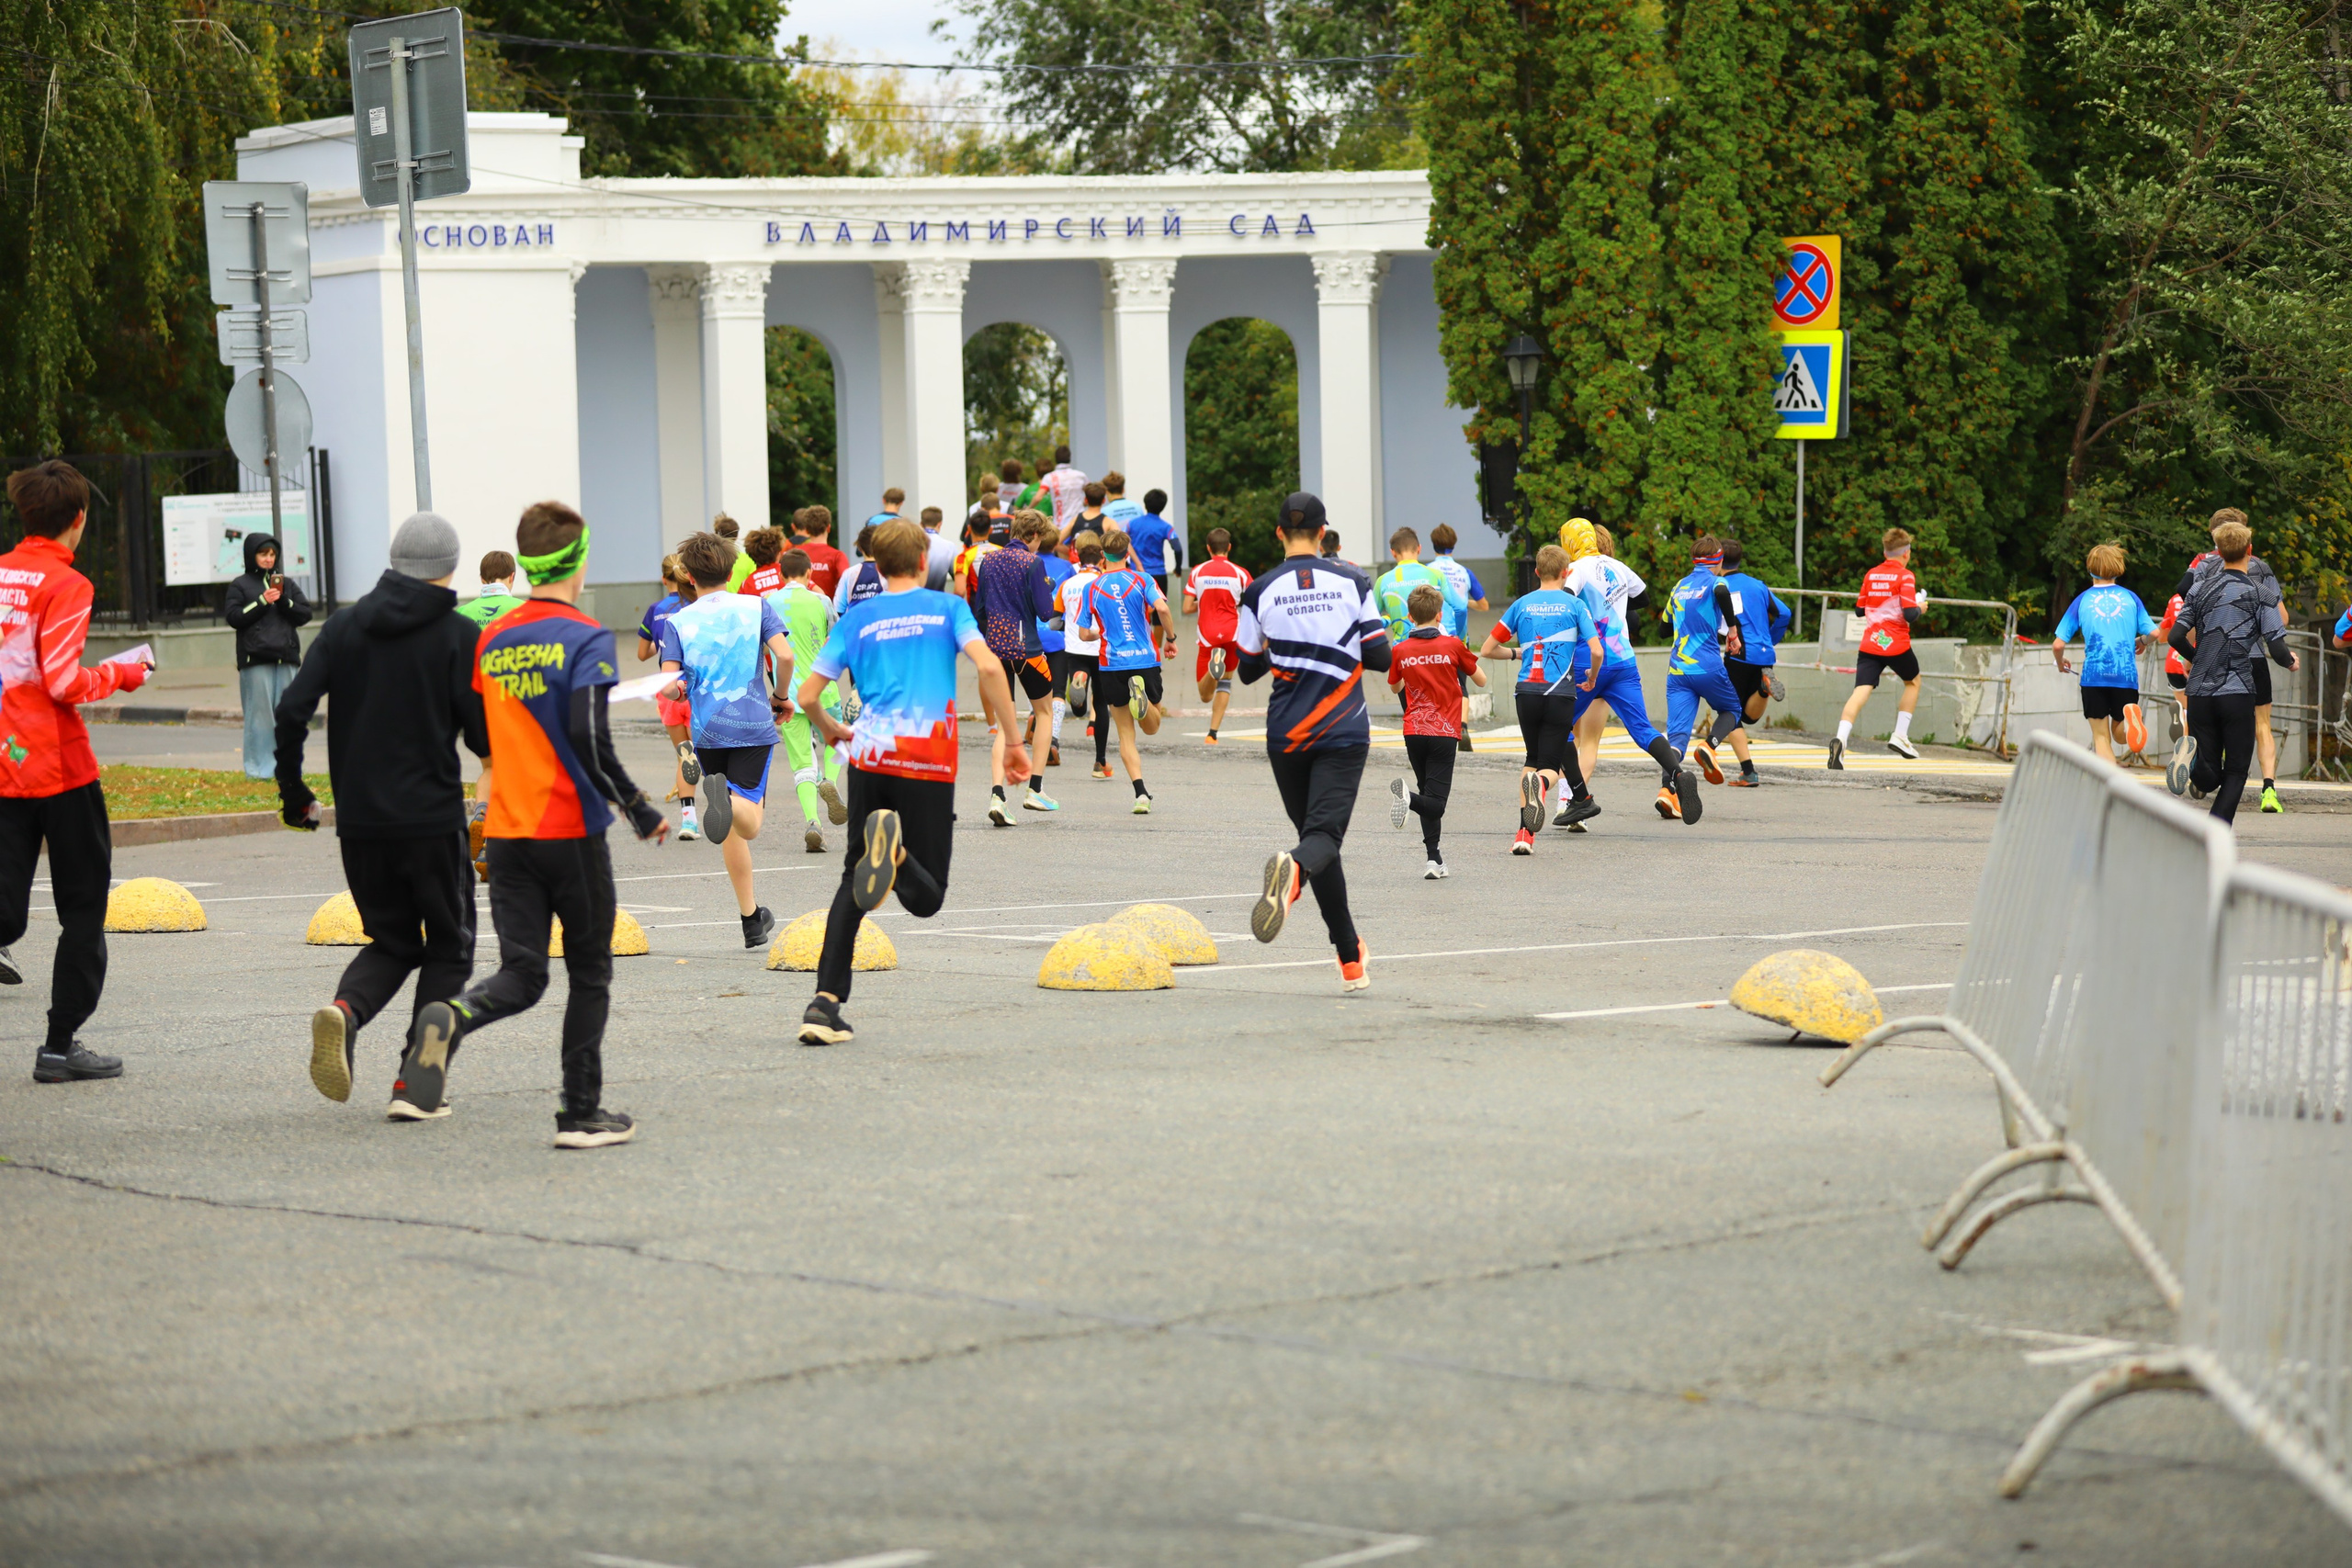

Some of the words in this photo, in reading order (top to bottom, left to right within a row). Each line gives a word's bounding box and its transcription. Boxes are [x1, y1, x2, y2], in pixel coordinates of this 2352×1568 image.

[766, 209, 1182, 243] ВЛАДИМИРСКИЙ
[1228, 213, 1316, 236] САД
[754, 575, 780, 591] STAR
[1204, 579, 1230, 587] RUSSIA
[1386, 578, 1430, 590] УЛЬЯНОВСК
[1273, 591, 1343, 607] Ивановская
[1110, 582, 1136, 642] ВОРОНЕЖ
[1286, 603, 1334, 617] область
[875, 624, 924, 642] ОБЛАСТЬ
[1400, 654, 1452, 670] МОСКВА
[494, 671, 548, 702] TRAIL
